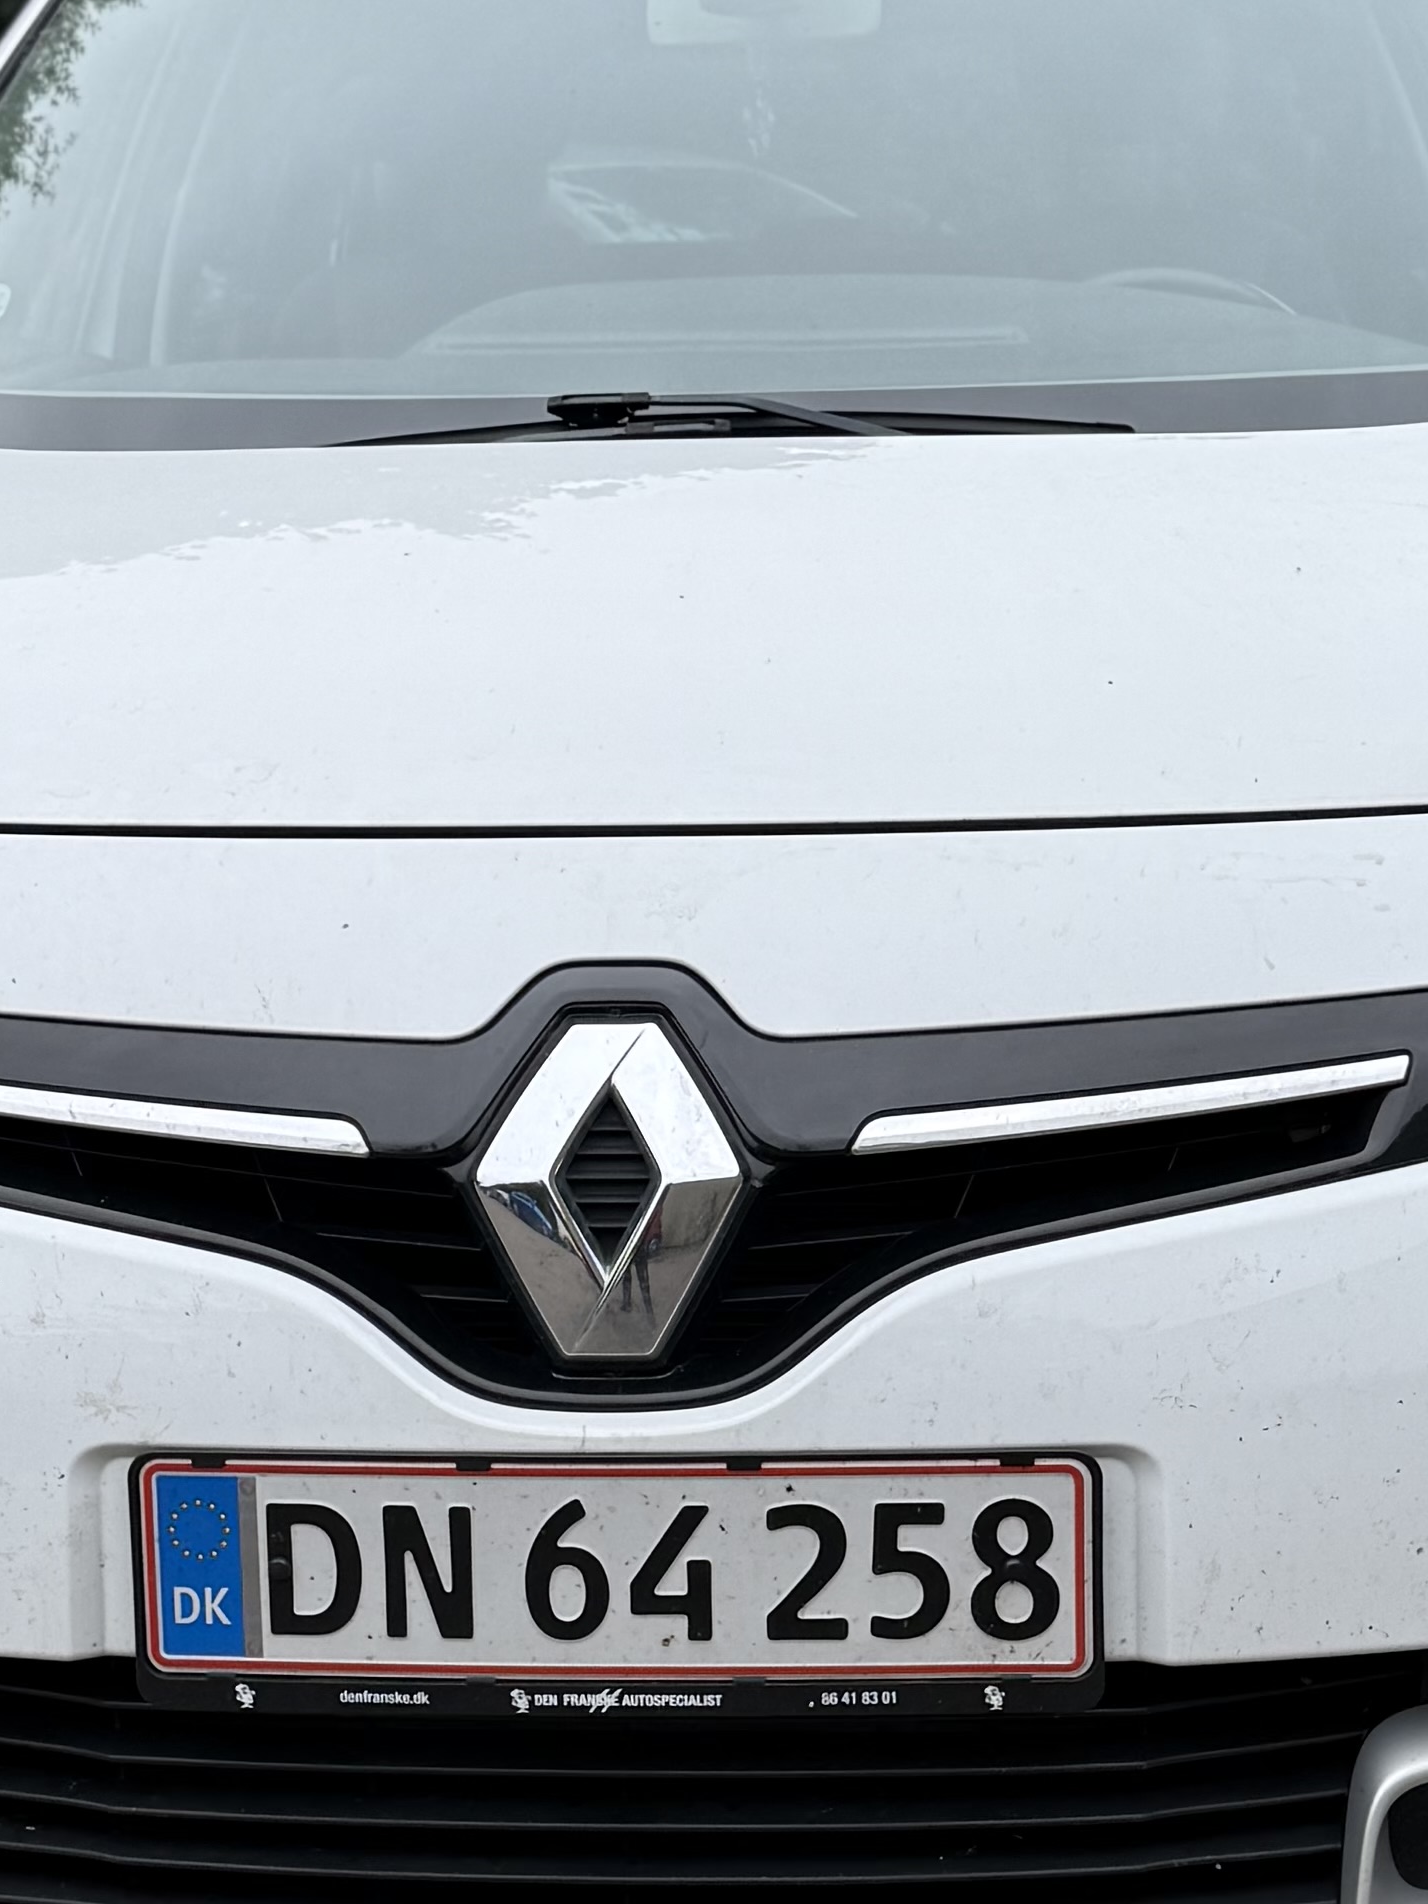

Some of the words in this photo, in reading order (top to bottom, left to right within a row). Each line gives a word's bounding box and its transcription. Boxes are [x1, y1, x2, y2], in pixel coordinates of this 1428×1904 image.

[266, 1503, 474, 1639] DN
[525, 1499, 713, 1641] 64
[765, 1499, 1060, 1641] 258
[173, 1586, 232, 1625] DK
[339, 1689, 430, 1705] denfranske.dk
[533, 1694, 558, 1707] DEN
[622, 1693, 722, 1707] AUTOSPECIALIST
[841, 1691, 856, 1705] 41
[882, 1691, 897, 1704] 01
